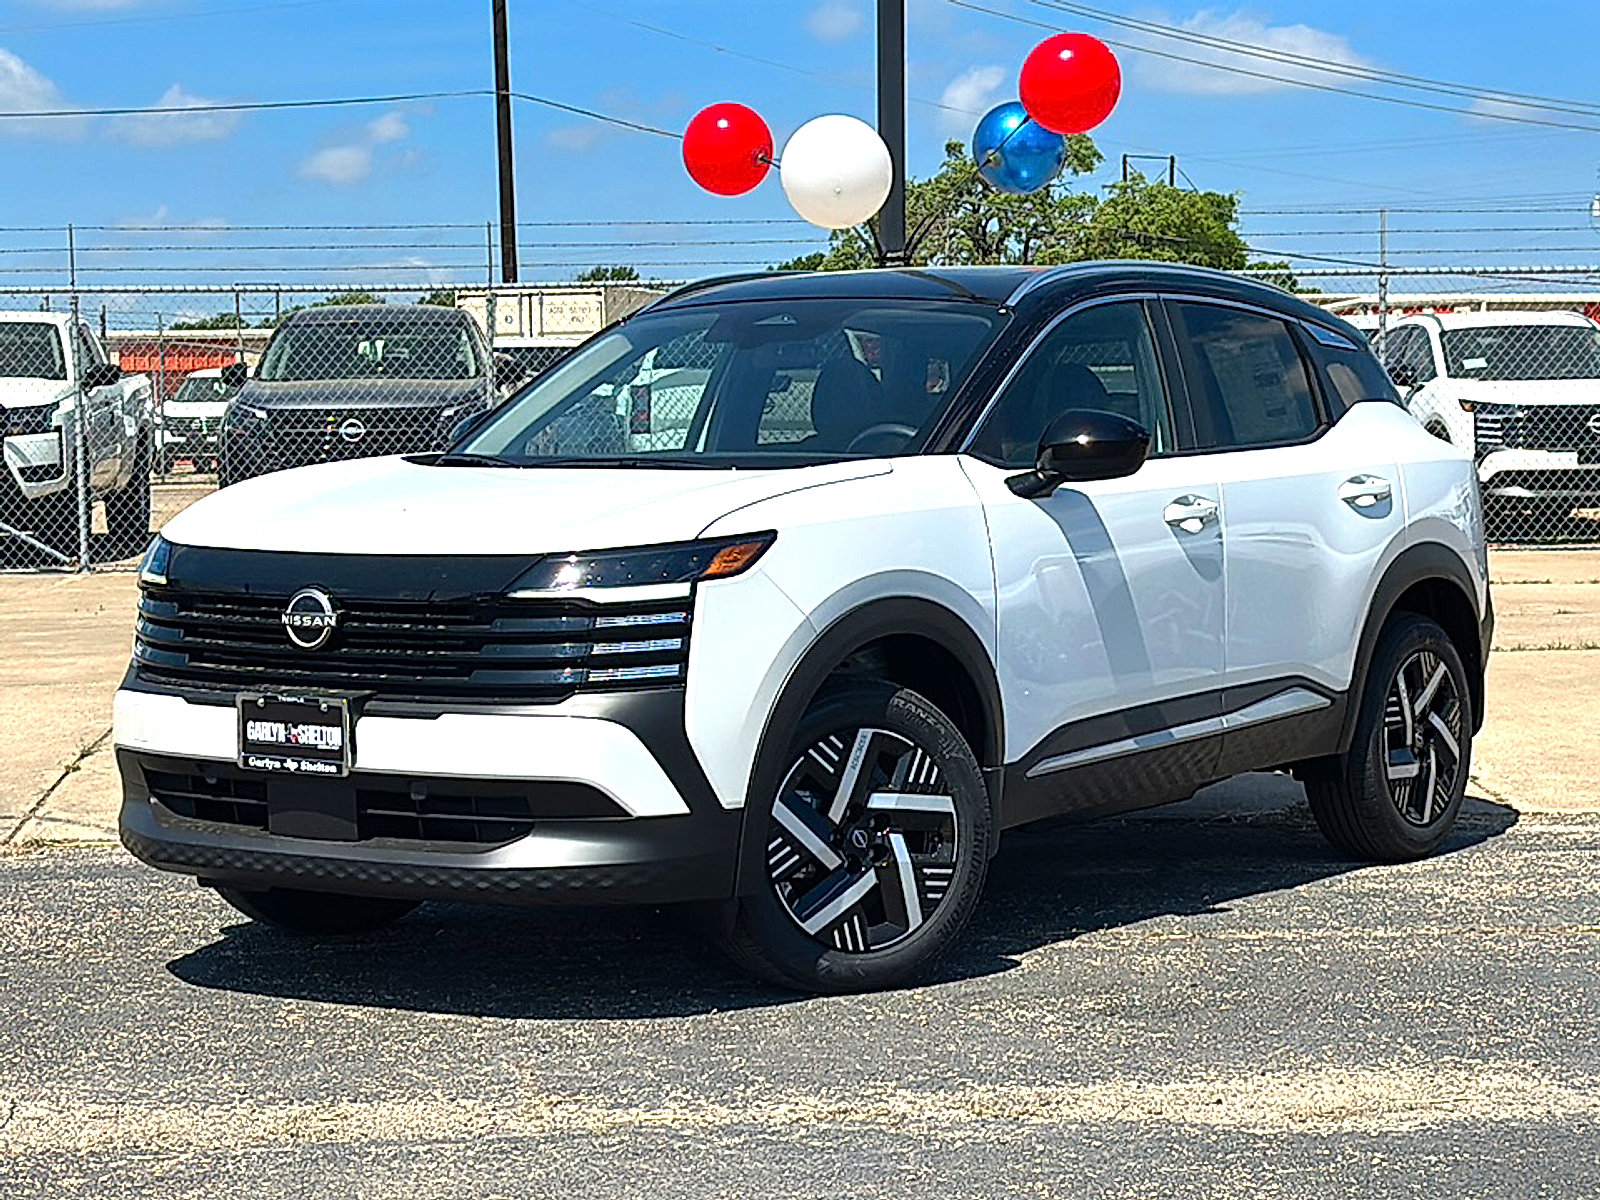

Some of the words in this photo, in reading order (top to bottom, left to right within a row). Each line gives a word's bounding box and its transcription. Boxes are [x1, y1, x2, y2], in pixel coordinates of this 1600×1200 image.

[281, 613, 337, 627] NISSAN
[246, 720, 286, 743] GARLYN
[297, 724, 342, 747] SHELTON
[300, 761, 338, 773] Shelton
